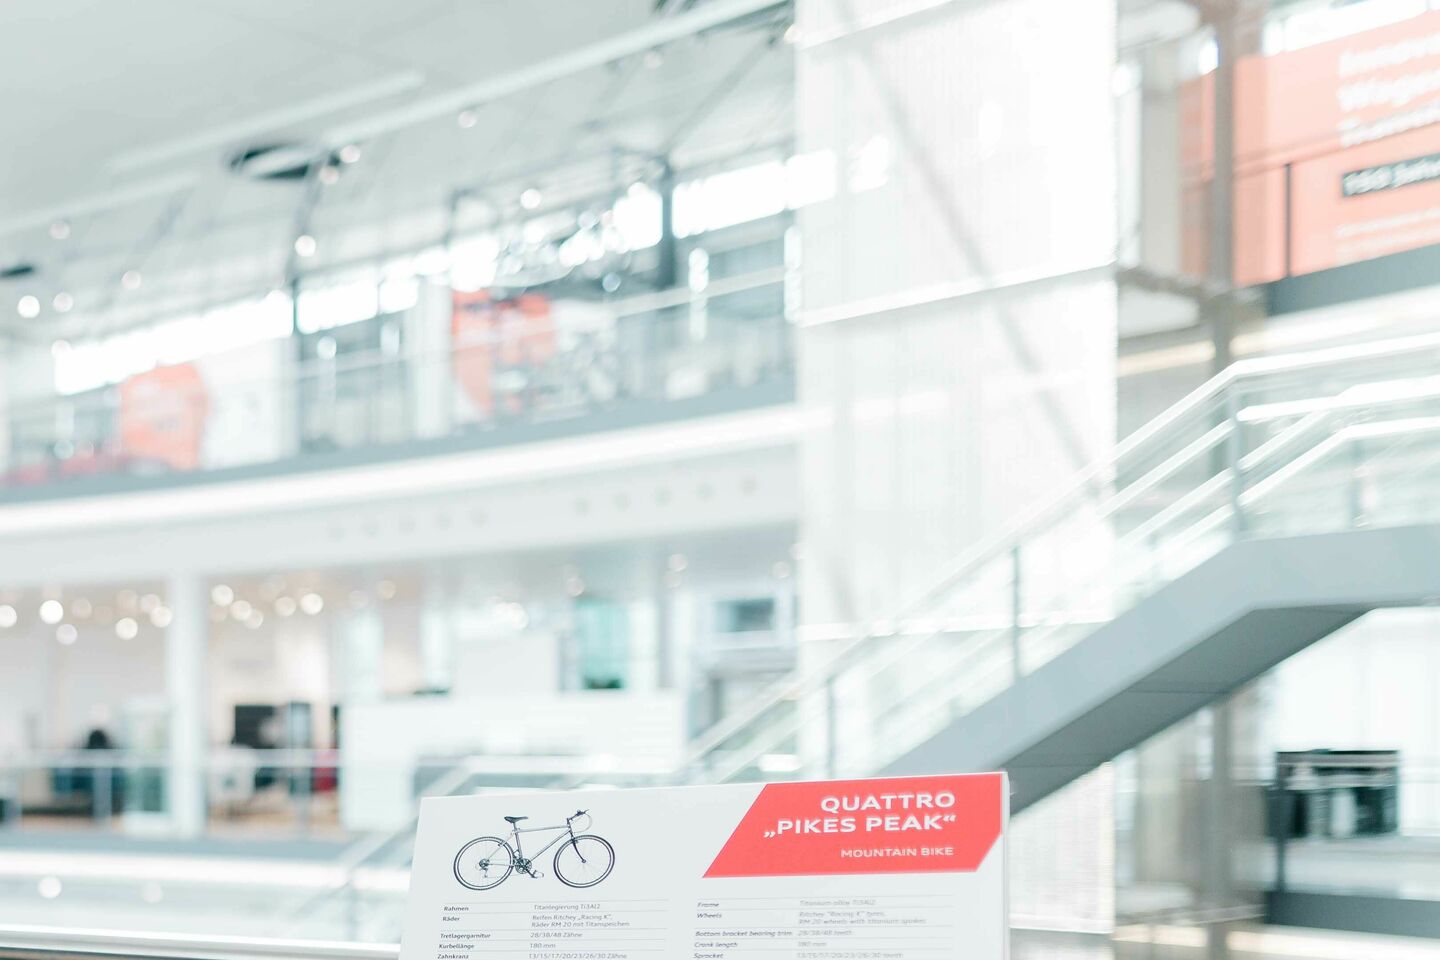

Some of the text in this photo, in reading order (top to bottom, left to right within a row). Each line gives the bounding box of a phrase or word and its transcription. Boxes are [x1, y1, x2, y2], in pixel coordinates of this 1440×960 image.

[820, 792, 956, 813] QUATTRO
[840, 847, 954, 858] MOUNTAIN BIKE
